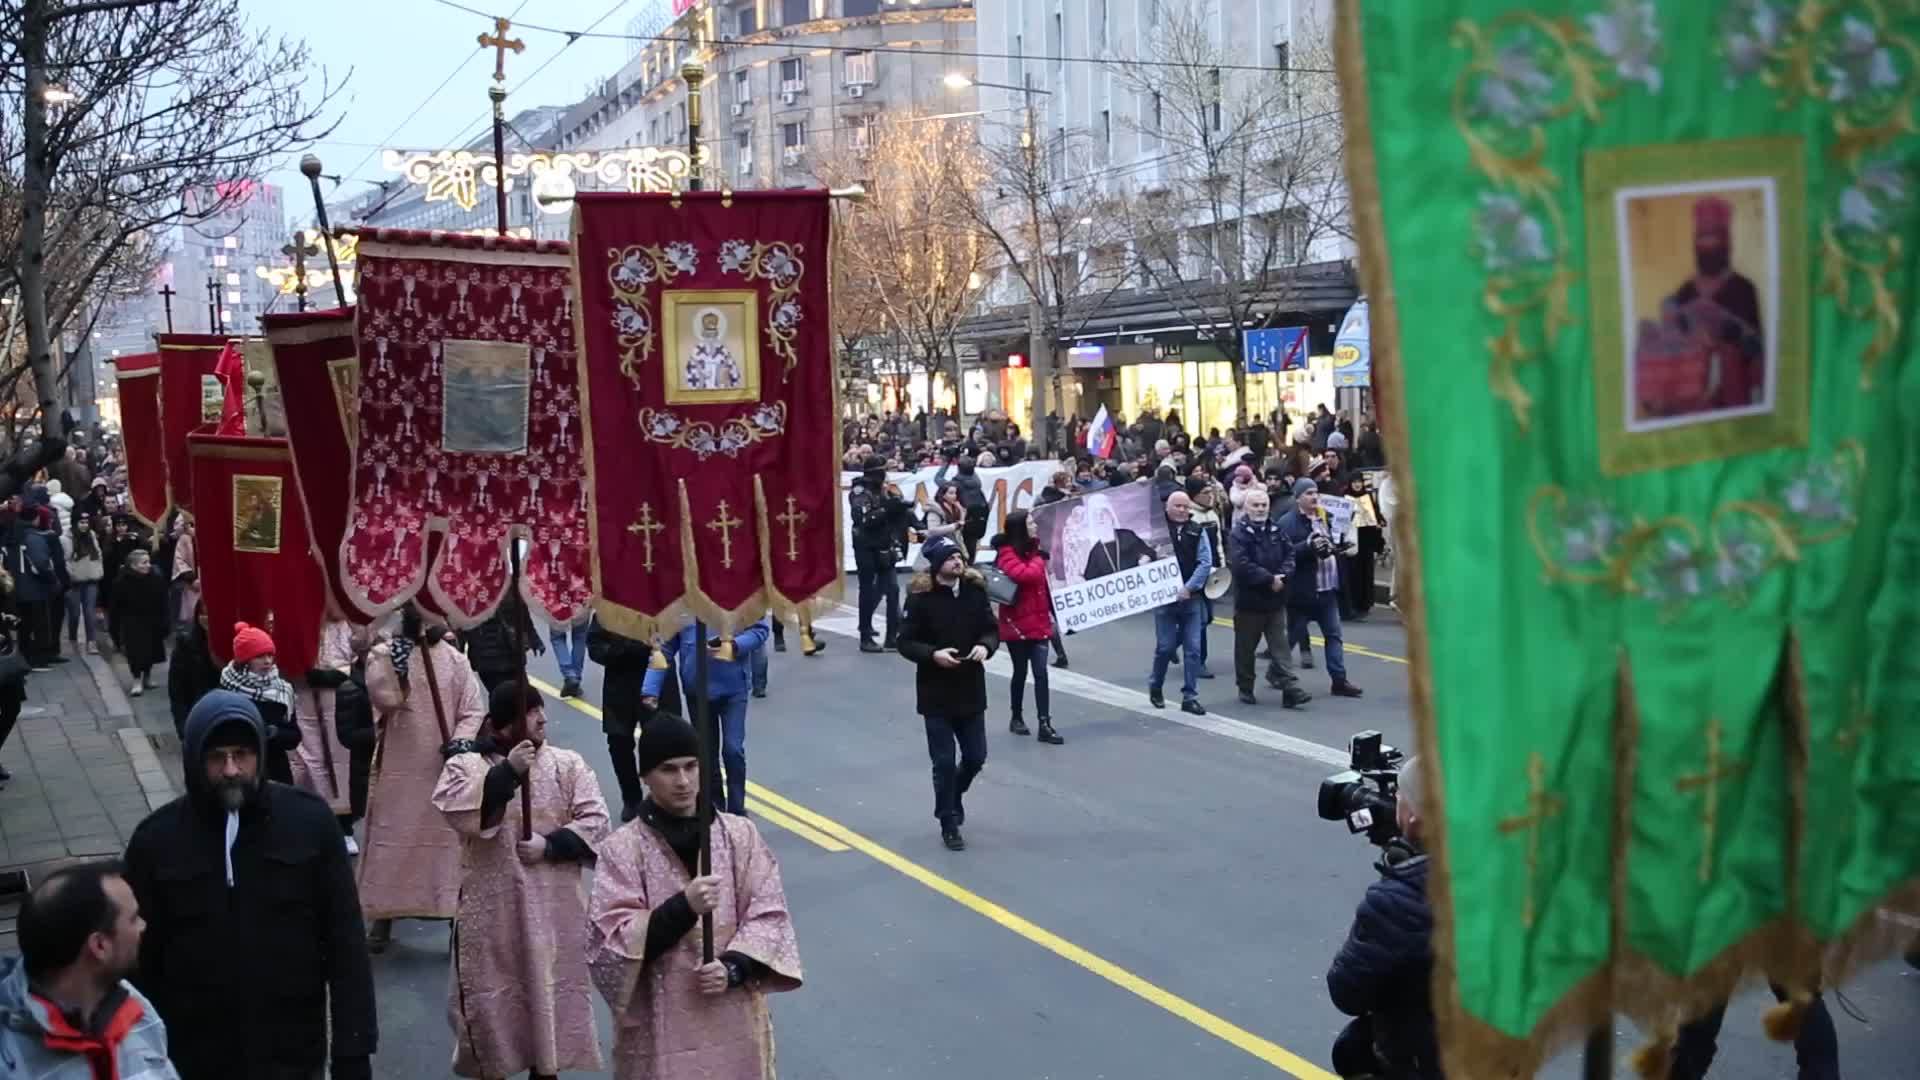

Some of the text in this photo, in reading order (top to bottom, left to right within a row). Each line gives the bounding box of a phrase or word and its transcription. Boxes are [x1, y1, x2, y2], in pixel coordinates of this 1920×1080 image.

[1054, 563, 1179, 611] БЕЗ КОСОВА СМО
[1066, 612, 1087, 626] као
[1090, 602, 1124, 618] човек
[1128, 595, 1149, 609] без
